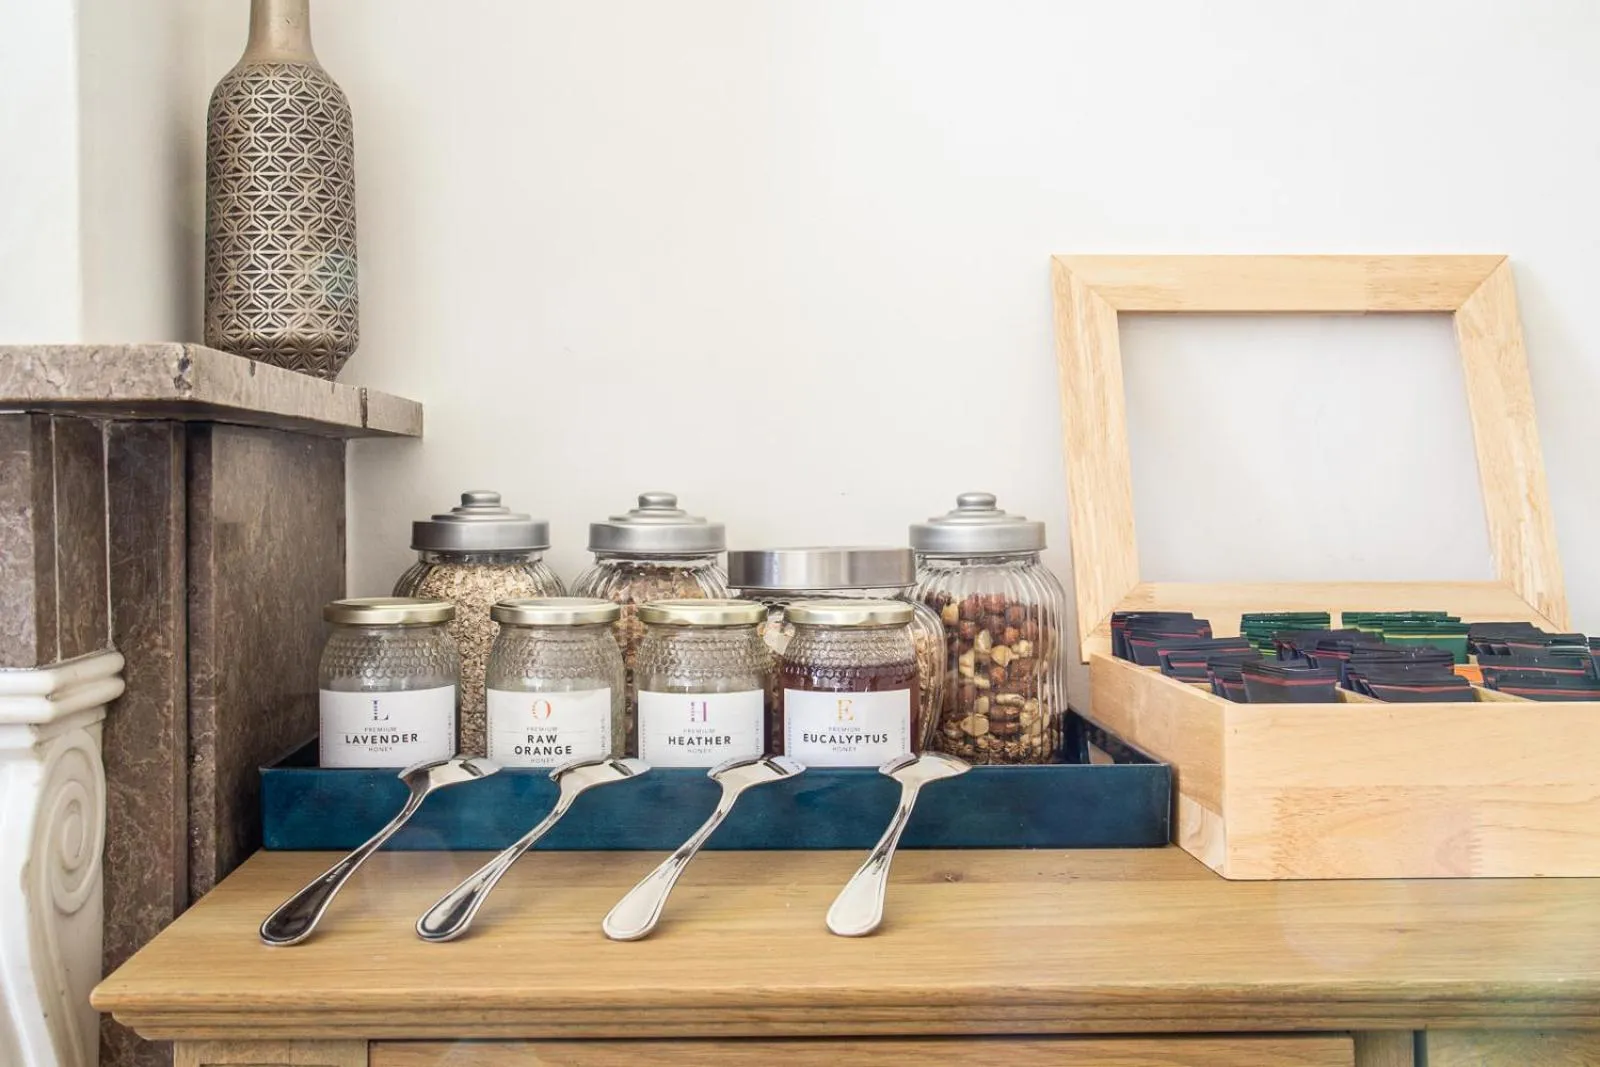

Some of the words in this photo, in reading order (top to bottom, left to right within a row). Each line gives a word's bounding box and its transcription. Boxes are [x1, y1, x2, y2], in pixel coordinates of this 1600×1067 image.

[371, 700, 389, 720] L
[691, 702, 707, 722] H
[838, 700, 854, 721] E
[345, 734, 418, 744] LAVENDER
[528, 734, 558, 744] RAW
[668, 736, 732, 746] HEATHER
[803, 734, 888, 744] EUCALYPTUS
[514, 746, 572, 755] ORANGE
